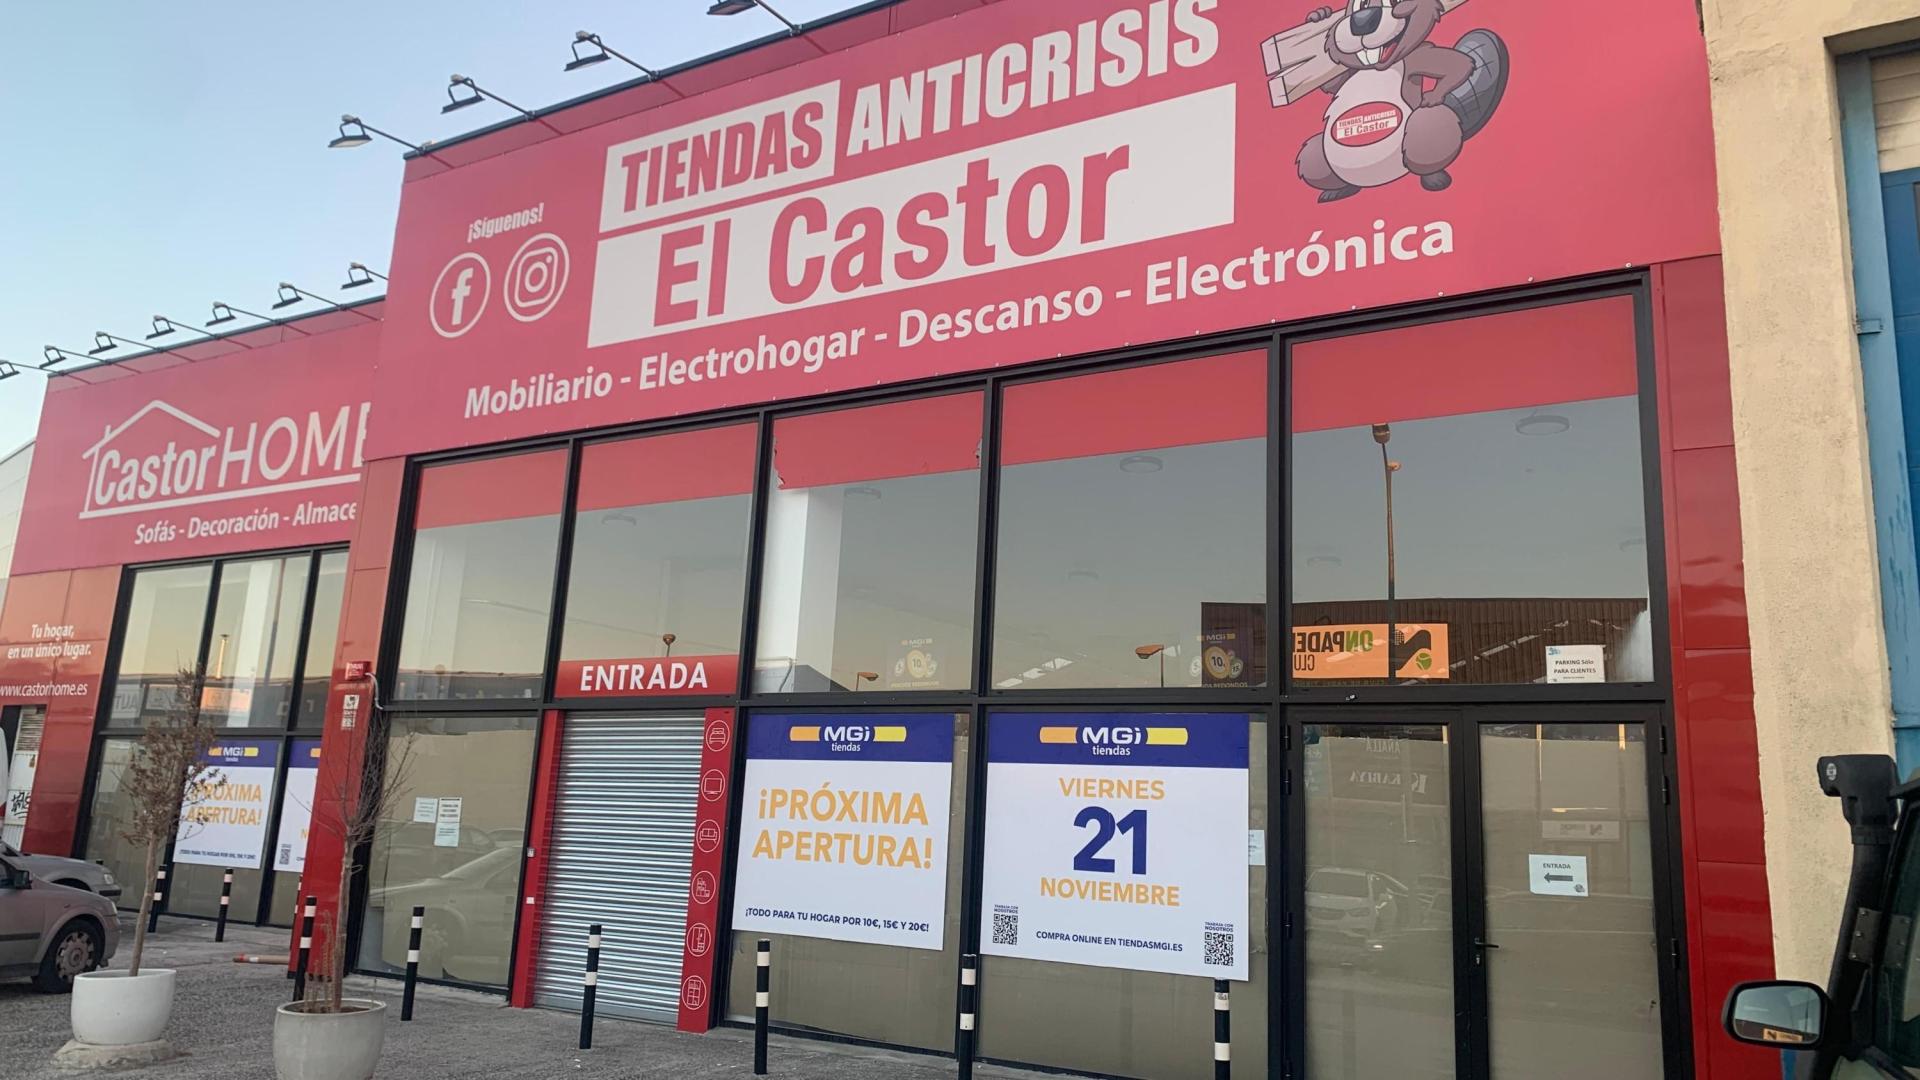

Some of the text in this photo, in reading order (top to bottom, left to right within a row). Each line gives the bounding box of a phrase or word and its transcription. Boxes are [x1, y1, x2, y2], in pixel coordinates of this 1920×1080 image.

[621, 0, 1219, 213] TIENDAS ANTICRISIS
[1339, 110, 1396, 127] TIENDAS ANTICRISIS
[1344, 120, 1389, 136] El Castor
[467, 202, 545, 243] ¡Síguenos!
[654, 144, 1129, 327] El Castor
[464, 366, 613, 418] Mobiliario
[639, 327, 866, 390] Electrohogar
[898, 286, 1102, 347] Descanso
[1147, 219, 1454, 305] Electrónica
[134, 520, 176, 545] Sofás
[188, 507, 280, 538] Decoración
[31, 623, 74, 641] Tu hogar,
[8, 641, 92, 660] en un único lugar.
[0, 682, 89, 697] www.castorhome.es
[580, 662, 708, 691] ENTRADA
[831, 742, 861, 752] tiendas
[1092, 745, 1130, 756] tiendas
[1059, 777, 1165, 800] VIERNES
[758, 782, 929, 825] ¡PRÓXIMA
[752, 829, 932, 869] APERTURA!
[1074, 806, 1147, 875] 21
[1040, 877, 1180, 907] NOVIEMBRE
[745, 907, 929, 932] ¡TODO PARA TU HOGAR POR 10€, 15€ Y 20€!
[1036, 930, 1183, 952] COMPRA ONLINE EN TIENDASMGI.ES
